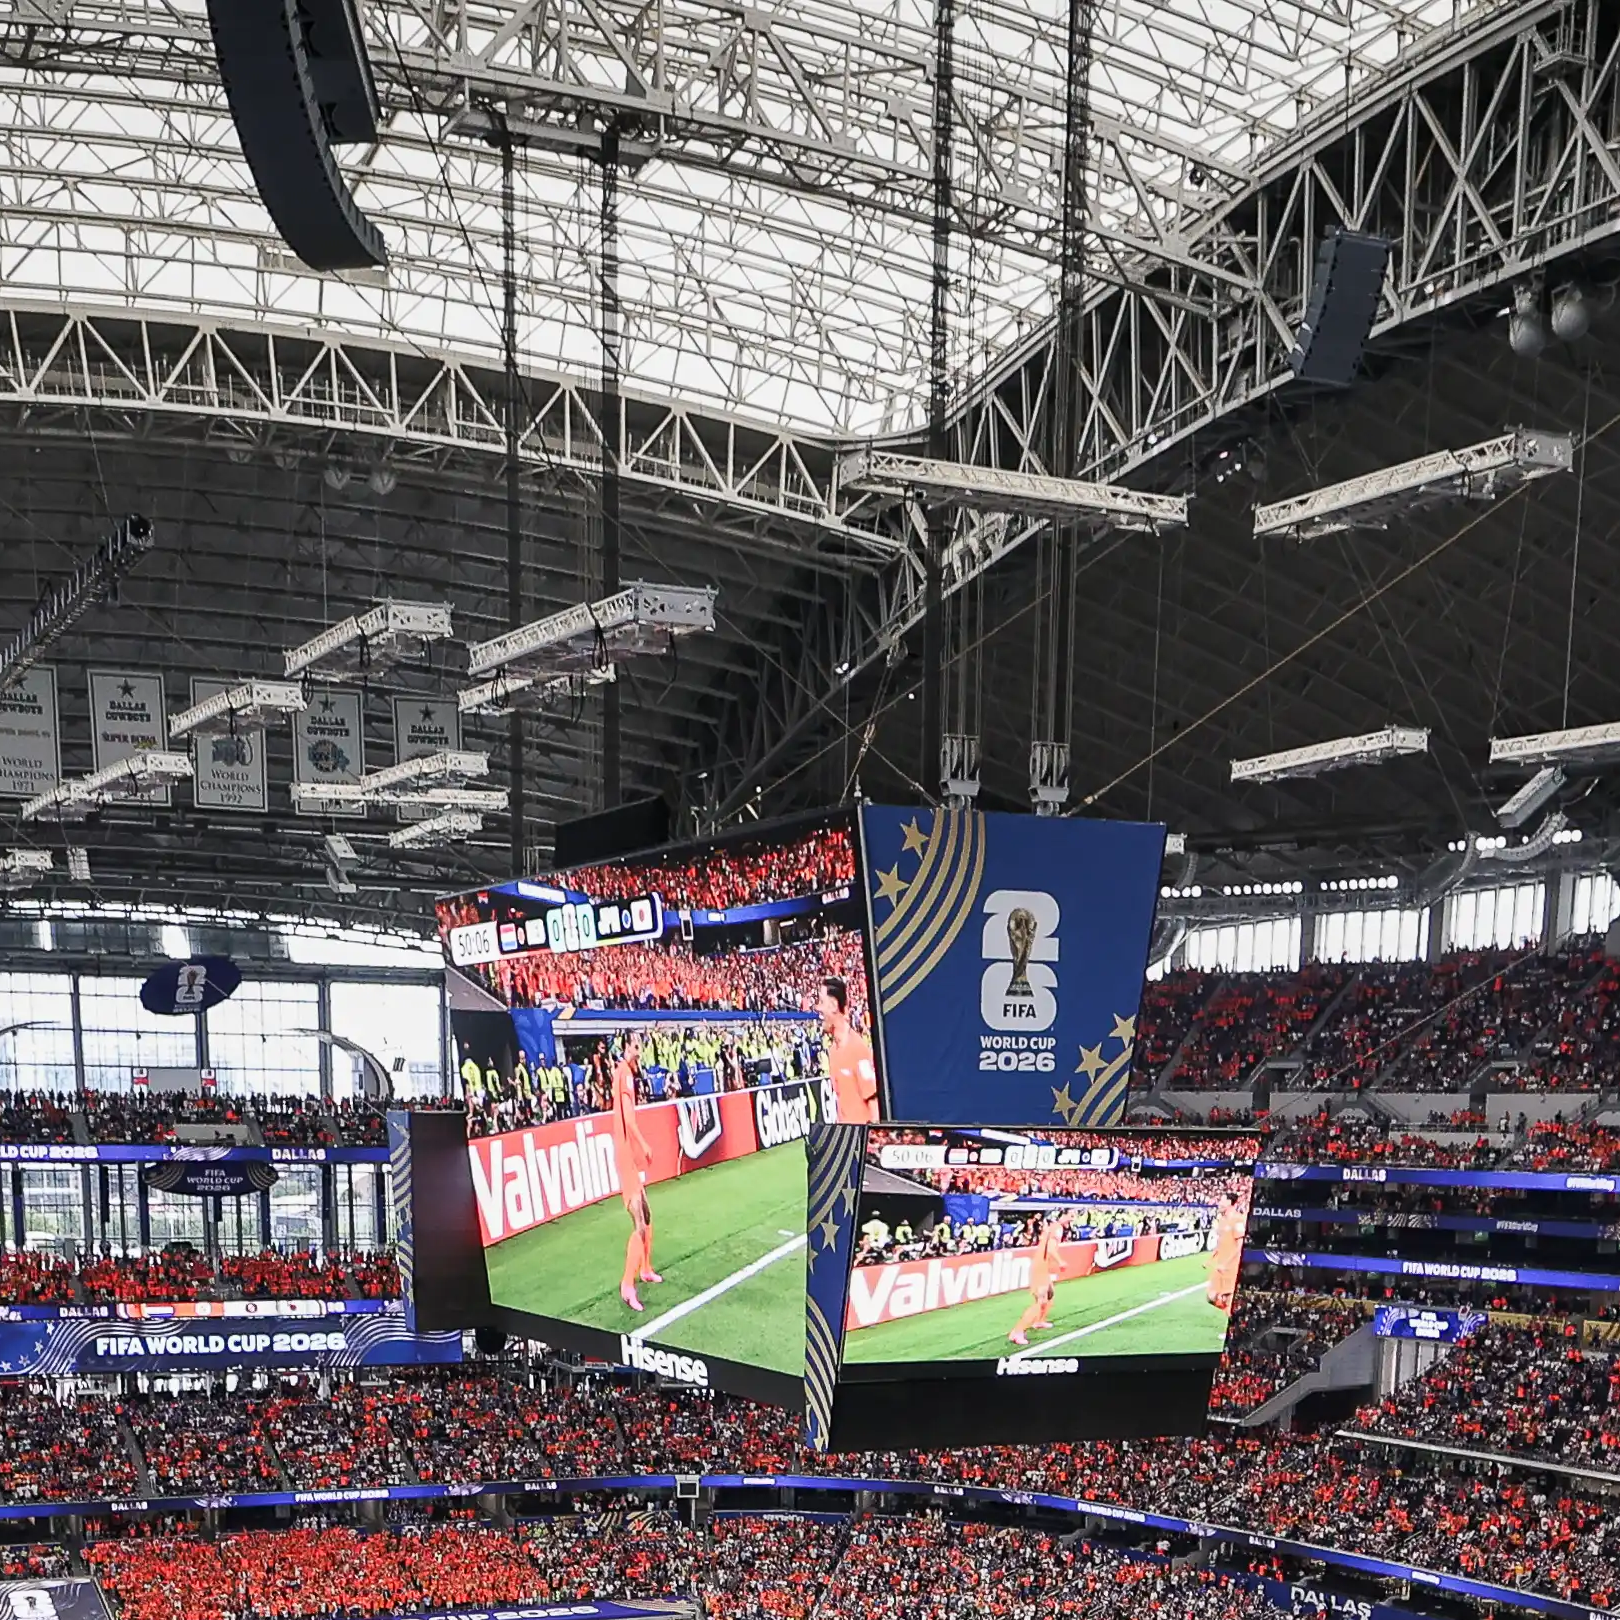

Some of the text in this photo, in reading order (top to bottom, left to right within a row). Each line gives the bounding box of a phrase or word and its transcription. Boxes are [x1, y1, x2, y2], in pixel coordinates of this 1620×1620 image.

[1, 755, 43, 768] WORLD
[211, 768, 249, 782] WORLD
[1003, 1003, 1037, 1018] FIFA
[980, 1035, 1056, 1050] WORLD CUP
[979, 1051, 1056, 1072] 2026
[20, 1145, 48, 1158] CUP
[49, 1145, 98, 1158] 2026
[271, 1148, 326, 1161] DALLAS
[204, 1168, 226, 1178] FIFA
[469, 1118, 622, 1240] Valvolin
[1342, 1167, 1387, 1182] DALLAS
[186, 1177, 244, 1185] WORLD CUP
[1252, 1207, 1302, 1219] DALLAS
[1402, 1261, 1517, 1282] FIFA WORLD CUP 2026
[848, 1249, 1033, 1328] Valvolin
[59, 1305, 109, 1318] DALLAS
[96, 1331, 346, 1358] FIFA WORLD CUP 2026
[621, 1334, 708, 1387] Hisense
[996, 1356, 1079, 1375] Hisense
[111, 1499, 148, 1512] DALLAS
[1290, 1585, 1374, 1618] DALLAS
[486, 1605, 600, 1620] 2026
